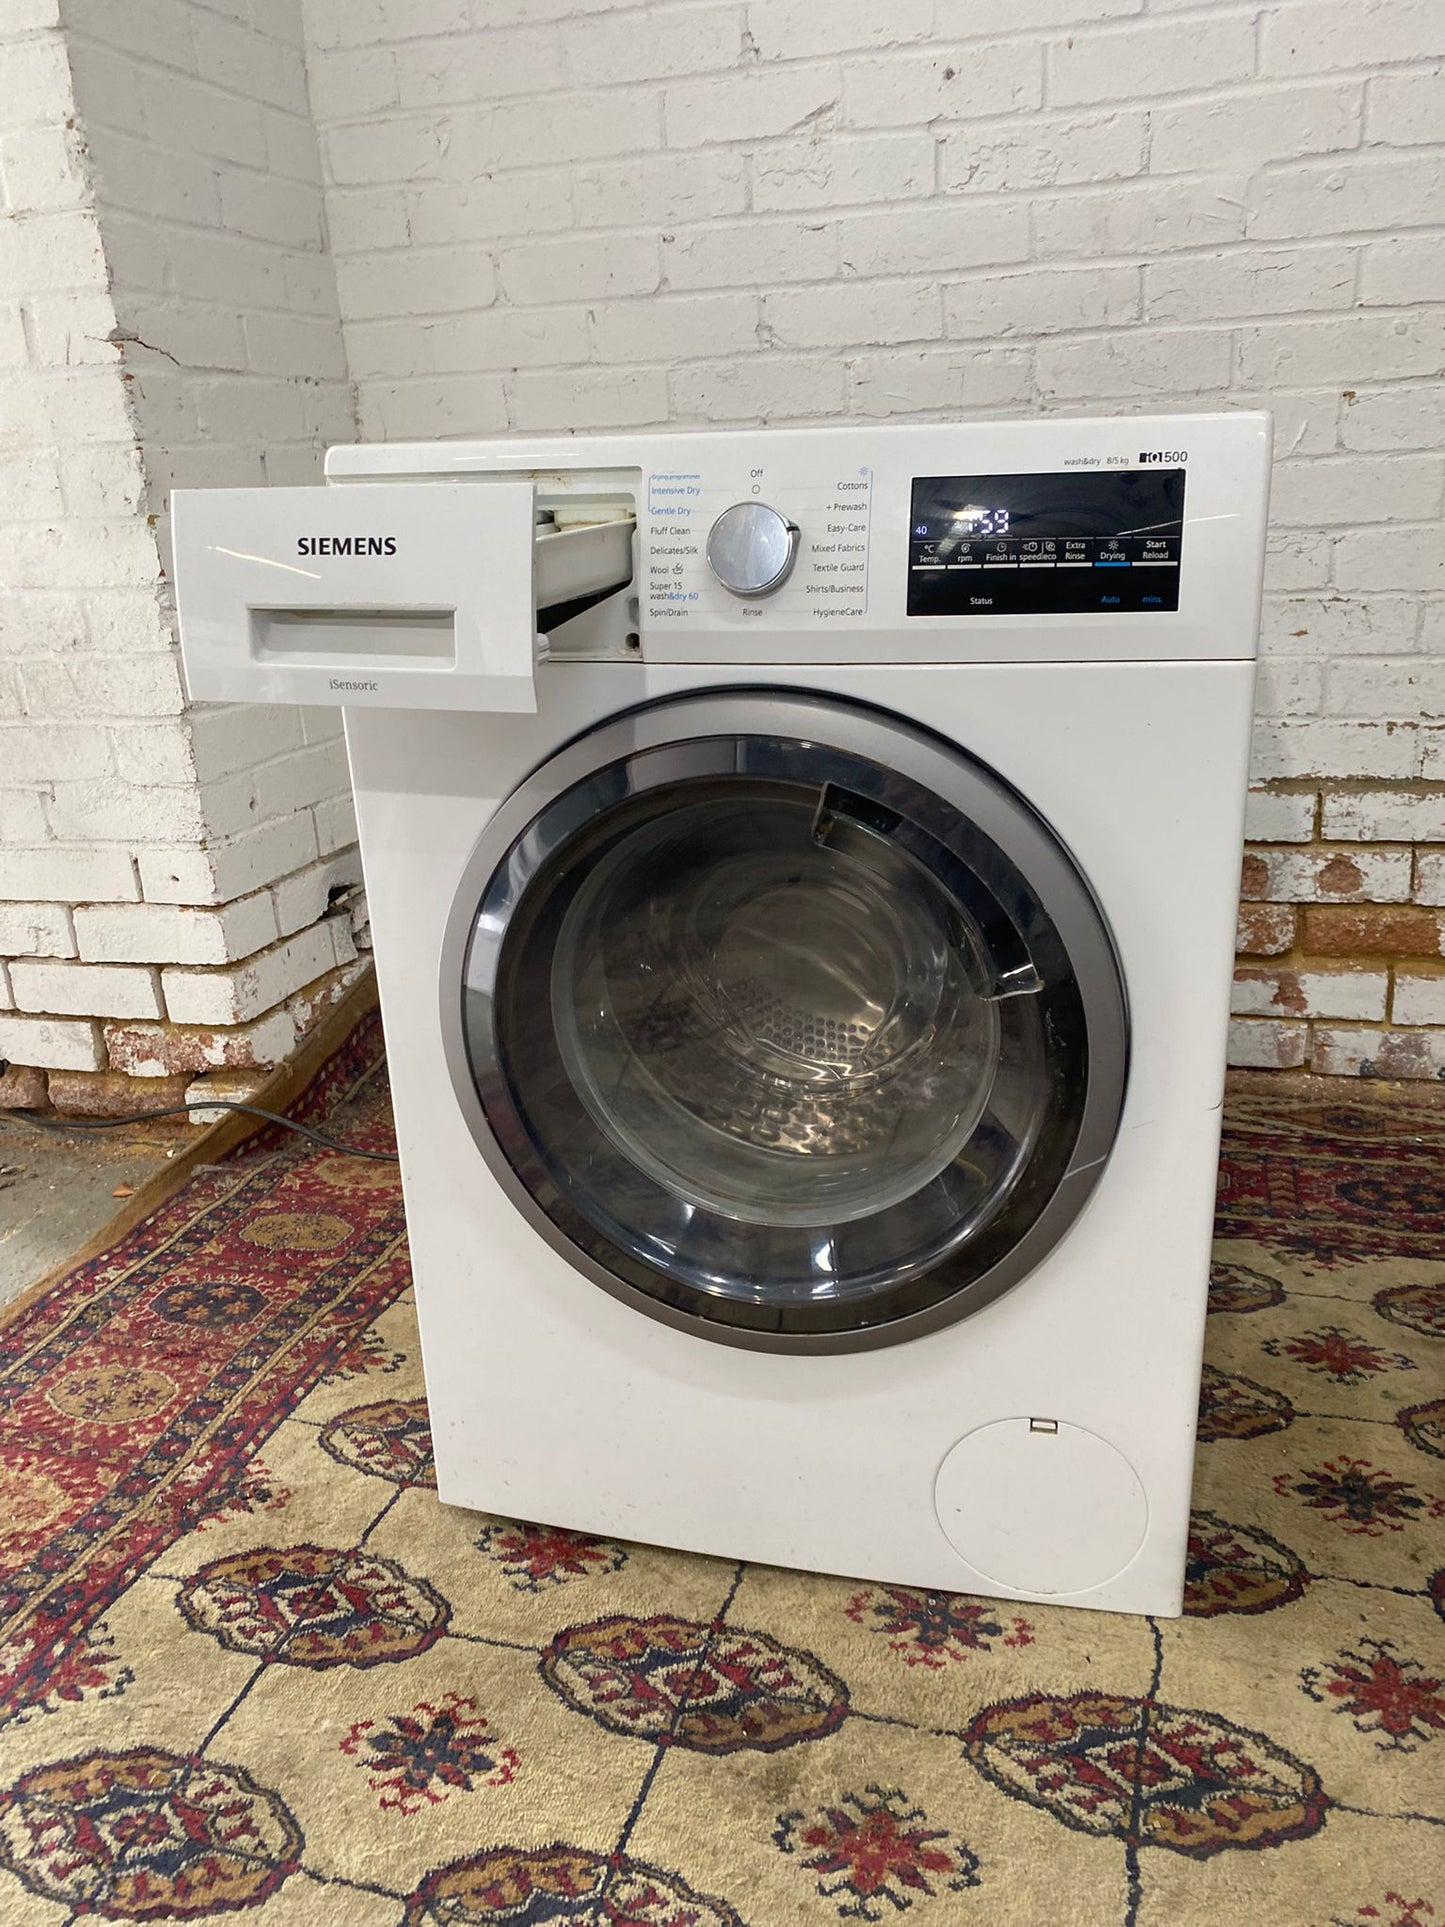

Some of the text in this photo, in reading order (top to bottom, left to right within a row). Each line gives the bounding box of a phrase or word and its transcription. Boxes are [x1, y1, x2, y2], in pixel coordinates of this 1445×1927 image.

[1064, 457, 1101, 466] wash&dry
[1120, 457, 1129, 465] kg
[750, 469, 763, 477] Off
[837, 482, 868, 490] Cottons
[652, 487, 700, 496] Intensive Dry
[651, 507, 691, 516] Gentle Dry
[833, 503, 867, 511] Prewash
[827, 524, 866, 534] Easy-Care
[915, 526, 928, 534] 40
[298, 537, 397, 556] SIEMENS
[811, 544, 865, 553] Mixed Fabrics
[1066, 541, 1086, 549] Extra
[650, 547, 698, 555] Delicates/Silk
[1143, 551, 1169, 560] Reload
[919, 555, 941, 563] Temp.
[958, 555, 972, 563] rpm
[986, 553, 1008, 561] Finish
[1065, 552, 1085, 560] Rinse
[1100, 551, 1125, 561] Drying
[650, 566, 669, 574] Wool
[813, 564, 864, 572] Textile Guard
[650, 582, 672, 591] Super
[806, 585, 864, 594] Shirts/Business
[650, 592, 698, 601] wash&dry 60
[970, 597, 993, 605] Status
[1101, 595, 1120, 604] Auto
[650, 608, 688, 618] Spin/Drain
[743, 609, 762, 617] Rinse
[813, 609, 863, 618] HygieneCare
[329, 678, 378, 691] iSensoric
